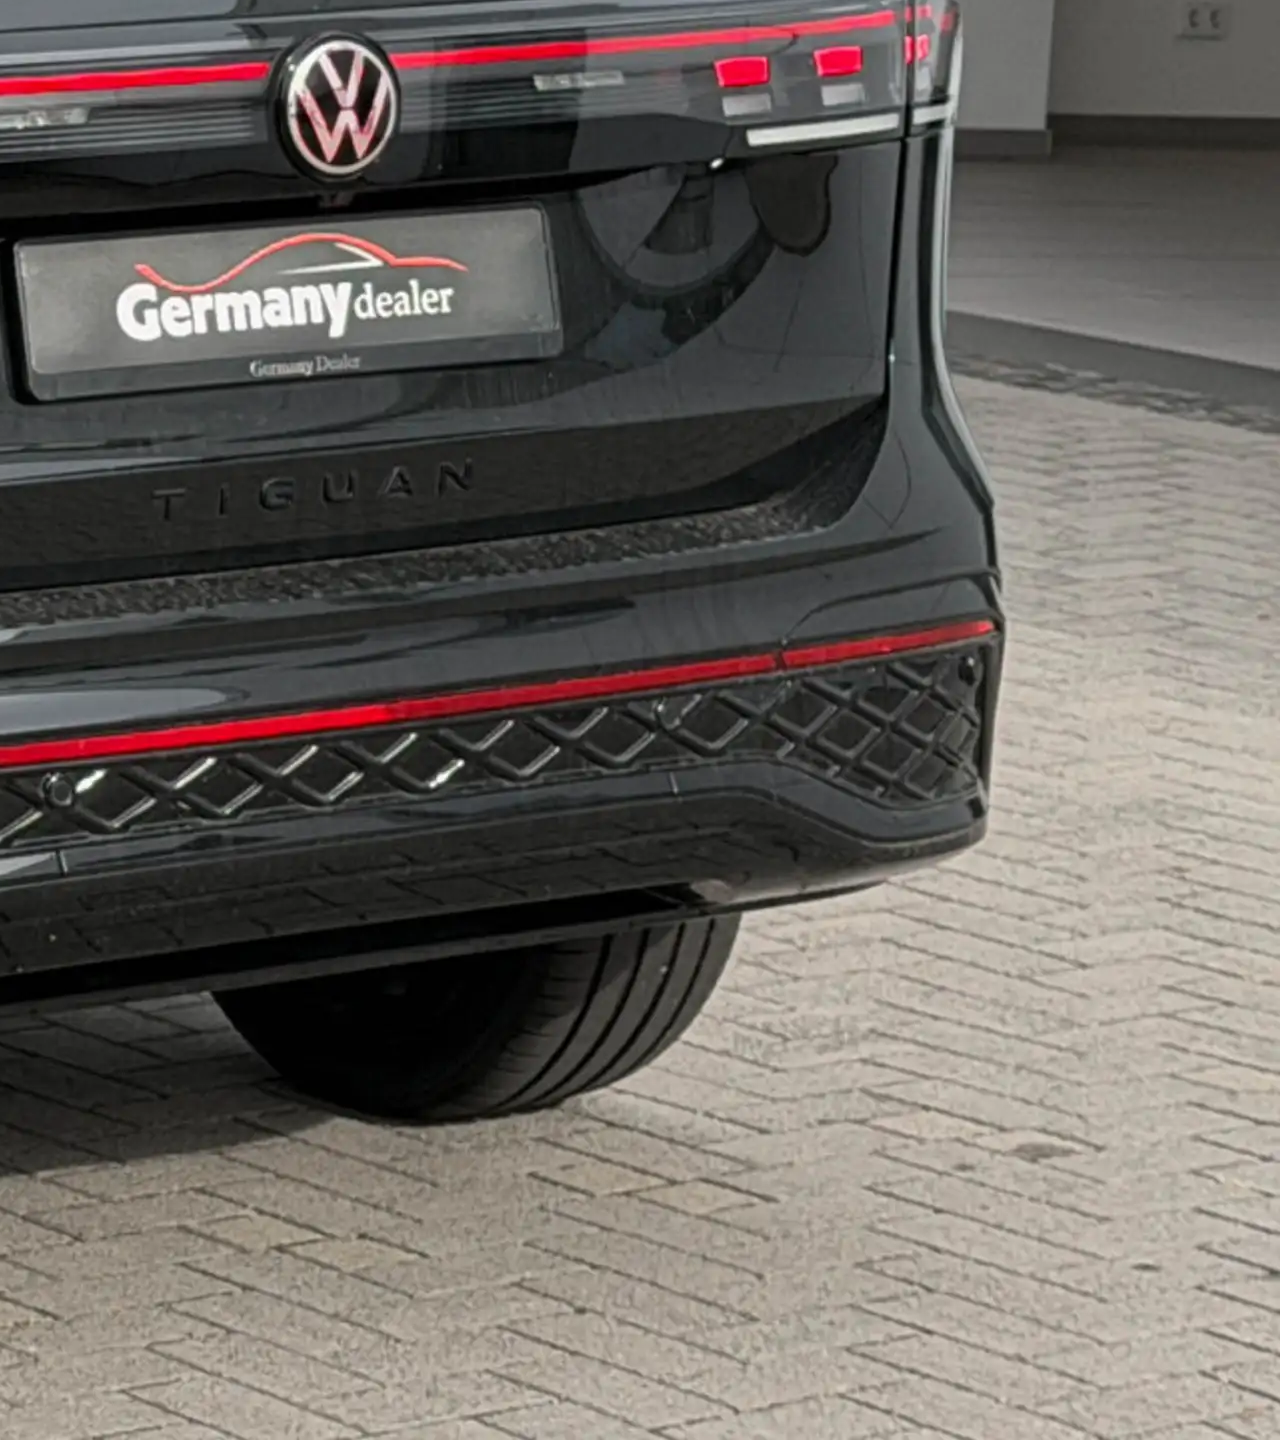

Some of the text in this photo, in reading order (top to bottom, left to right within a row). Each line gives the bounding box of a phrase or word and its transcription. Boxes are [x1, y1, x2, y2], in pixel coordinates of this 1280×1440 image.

[292, 45, 393, 169] VW
[116, 279, 455, 341] Germany dealer
[250, 355, 361, 378] Germany Dealer
[151, 458, 474, 521] TIGUAN
